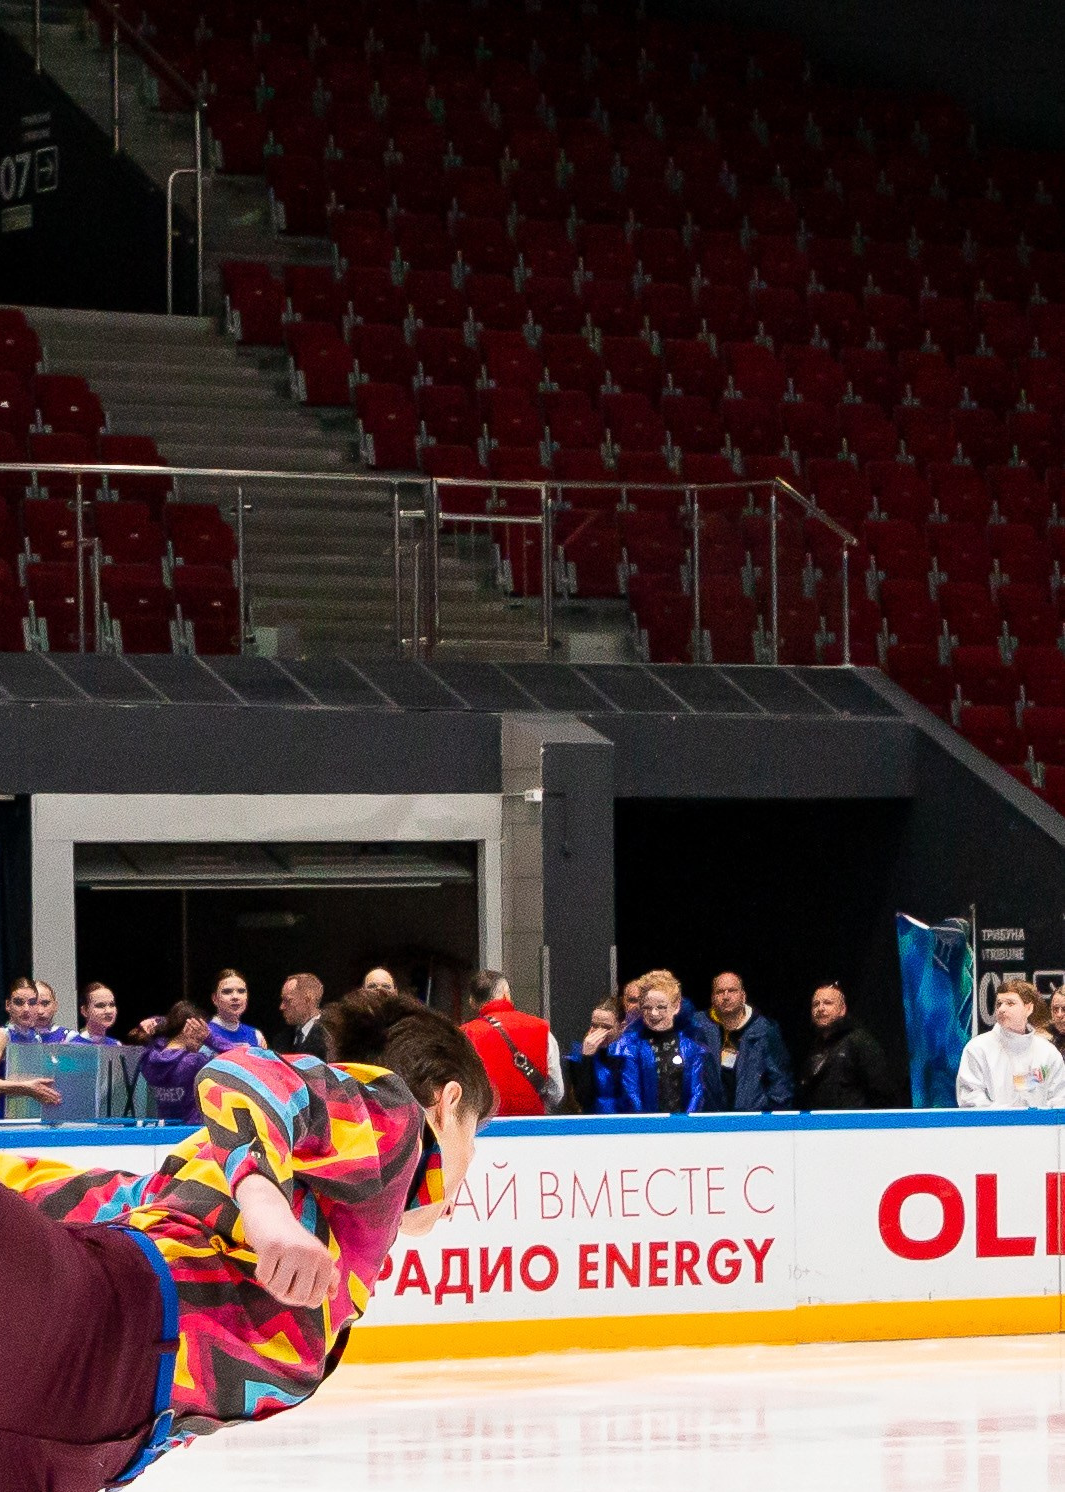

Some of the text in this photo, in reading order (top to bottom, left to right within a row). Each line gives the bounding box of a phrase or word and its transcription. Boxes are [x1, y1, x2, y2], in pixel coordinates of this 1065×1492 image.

[0, 151, 32, 200] 07
[539, 1167, 726, 1220] ВМЕСТЕ
[743, 1165, 775, 1214] С
[578, 1237, 775, 1291] ENERGY
